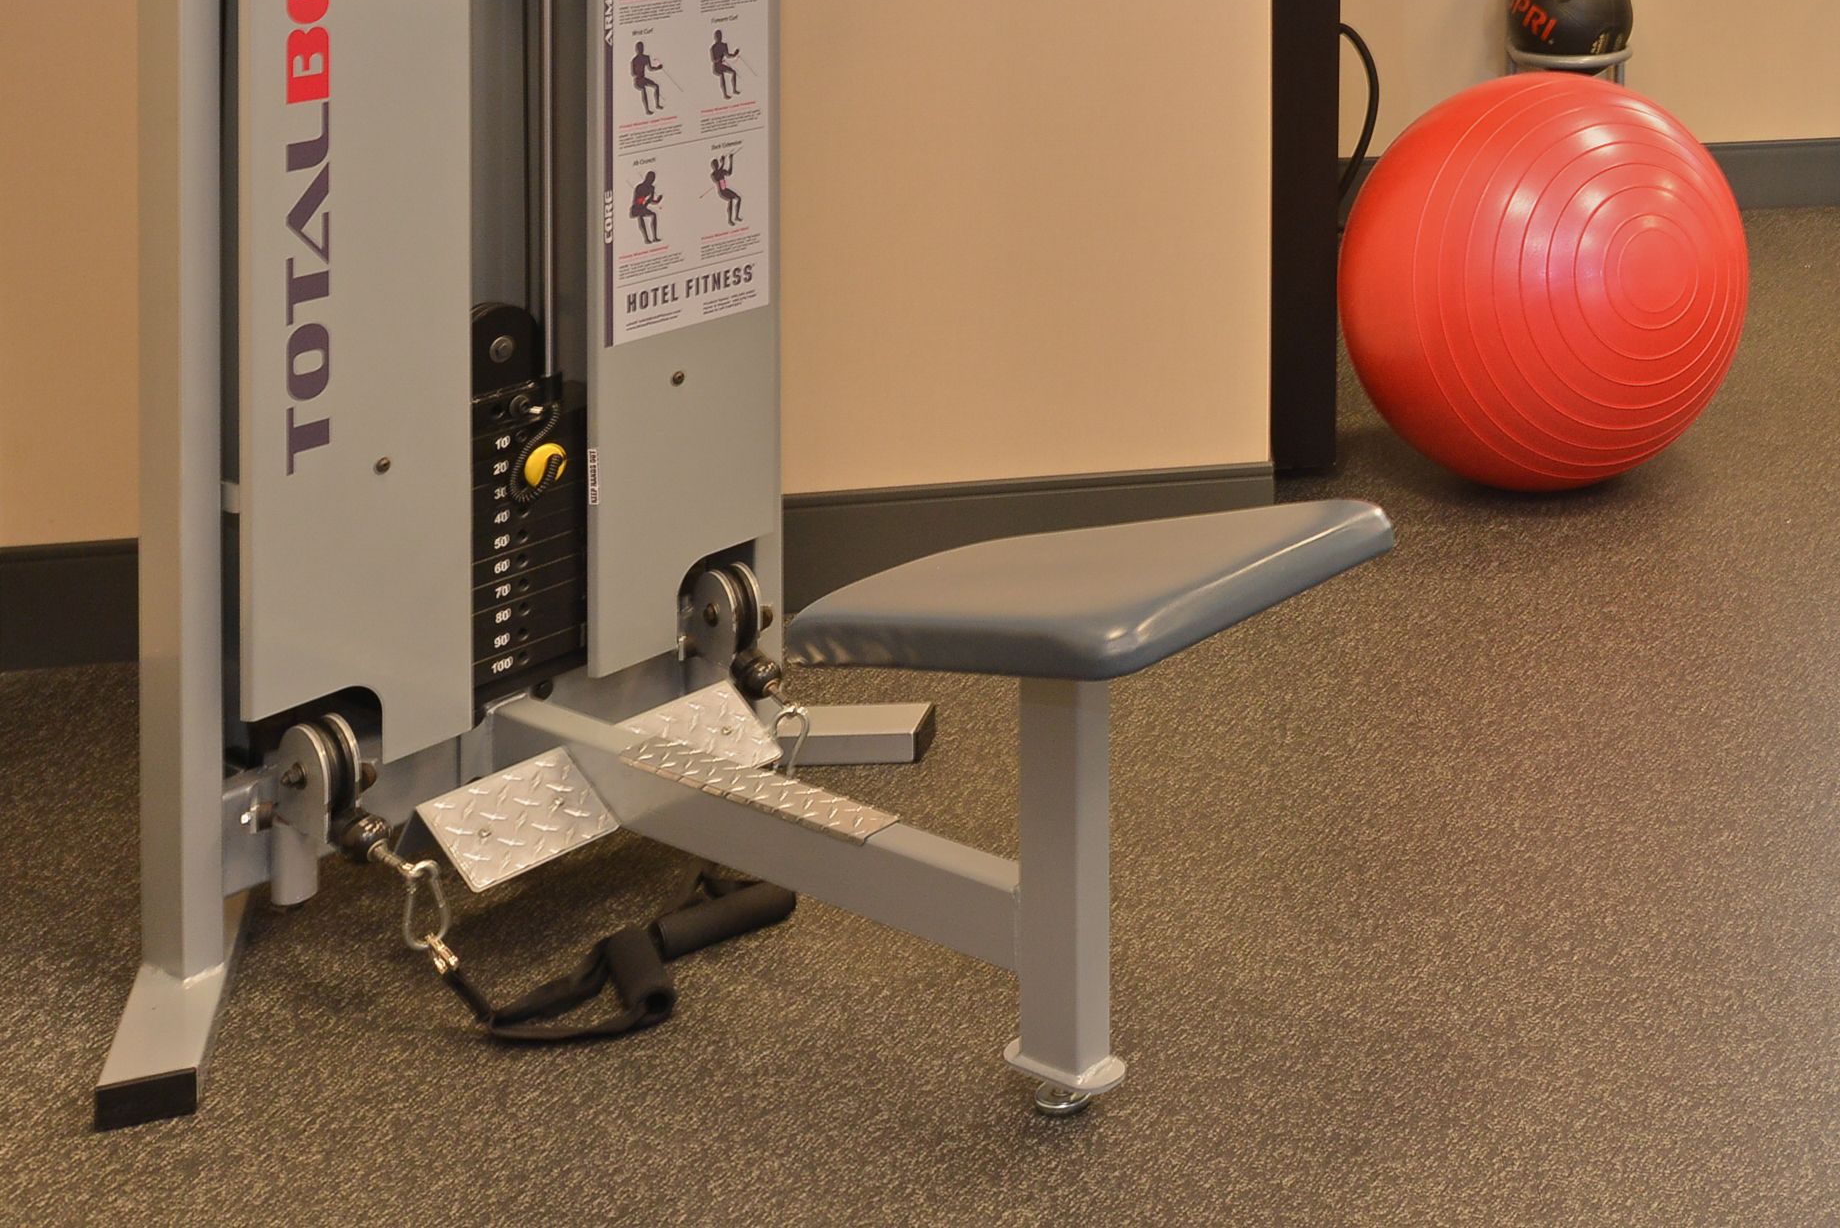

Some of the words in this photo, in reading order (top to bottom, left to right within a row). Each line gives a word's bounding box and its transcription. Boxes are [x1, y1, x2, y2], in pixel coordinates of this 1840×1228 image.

[604, 190, 613, 244] CORE
[626, 283, 679, 313] HOTEL
[685, 264, 753, 298] FITNESS
[495, 435, 510, 450] 10
[493, 460, 509, 475] 20
[494, 509, 510, 525] 40
[494, 534, 510, 550] 50
[494, 559, 510, 574] 60
[495, 584, 511, 599] 70
[495, 608, 511, 624] 80
[494, 633, 510, 649] 90
[491, 656, 513, 674] 100
